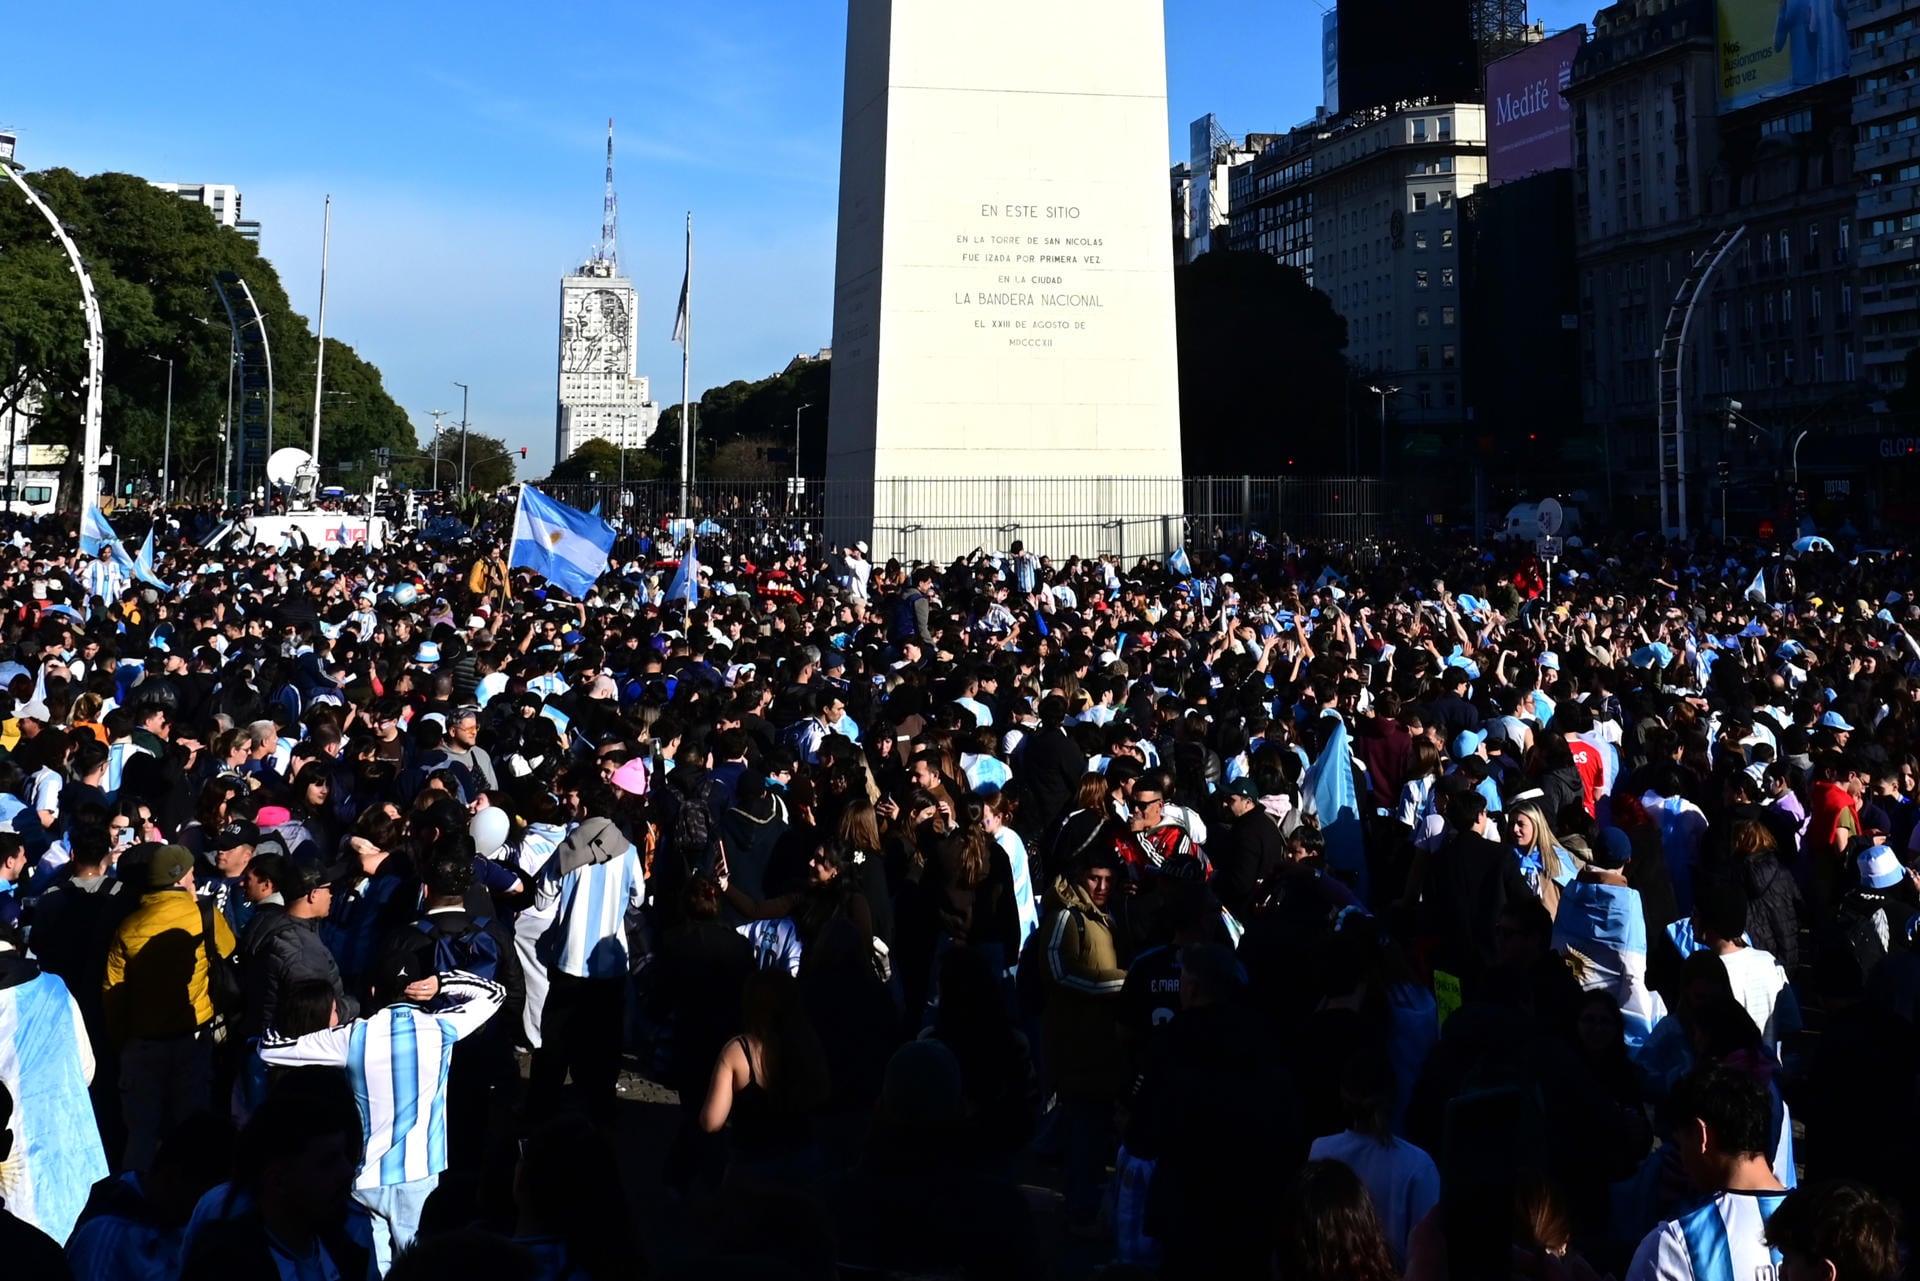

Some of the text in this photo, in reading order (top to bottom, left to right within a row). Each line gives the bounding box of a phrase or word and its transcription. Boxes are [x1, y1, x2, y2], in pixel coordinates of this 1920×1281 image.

[1723, 41, 1740, 56] Nos
[1723, 47, 1772, 72] ilusionamos
[1724, 69, 1756, 88] otra vez
[1496, 78, 1549, 126] Medifé
[981, 204, 1080, 219] EN ESTE SITIO
[956, 235, 1103, 247] EN LA TORRE DE SAN NICOLAS
[962, 253, 1101, 264] FUE IZADA POR PRIMERA VEZ
[998, 275, 1063, 285] EN LA CIUDAD
[955, 292, 1104, 308] LA BANDERA NACIONAL
[974, 319, 1086, 330] EL XXIII DE AGOSTO DE
[1009, 338, 1053, 348] MDCCCXII
[326, 528, 366, 541] A4
